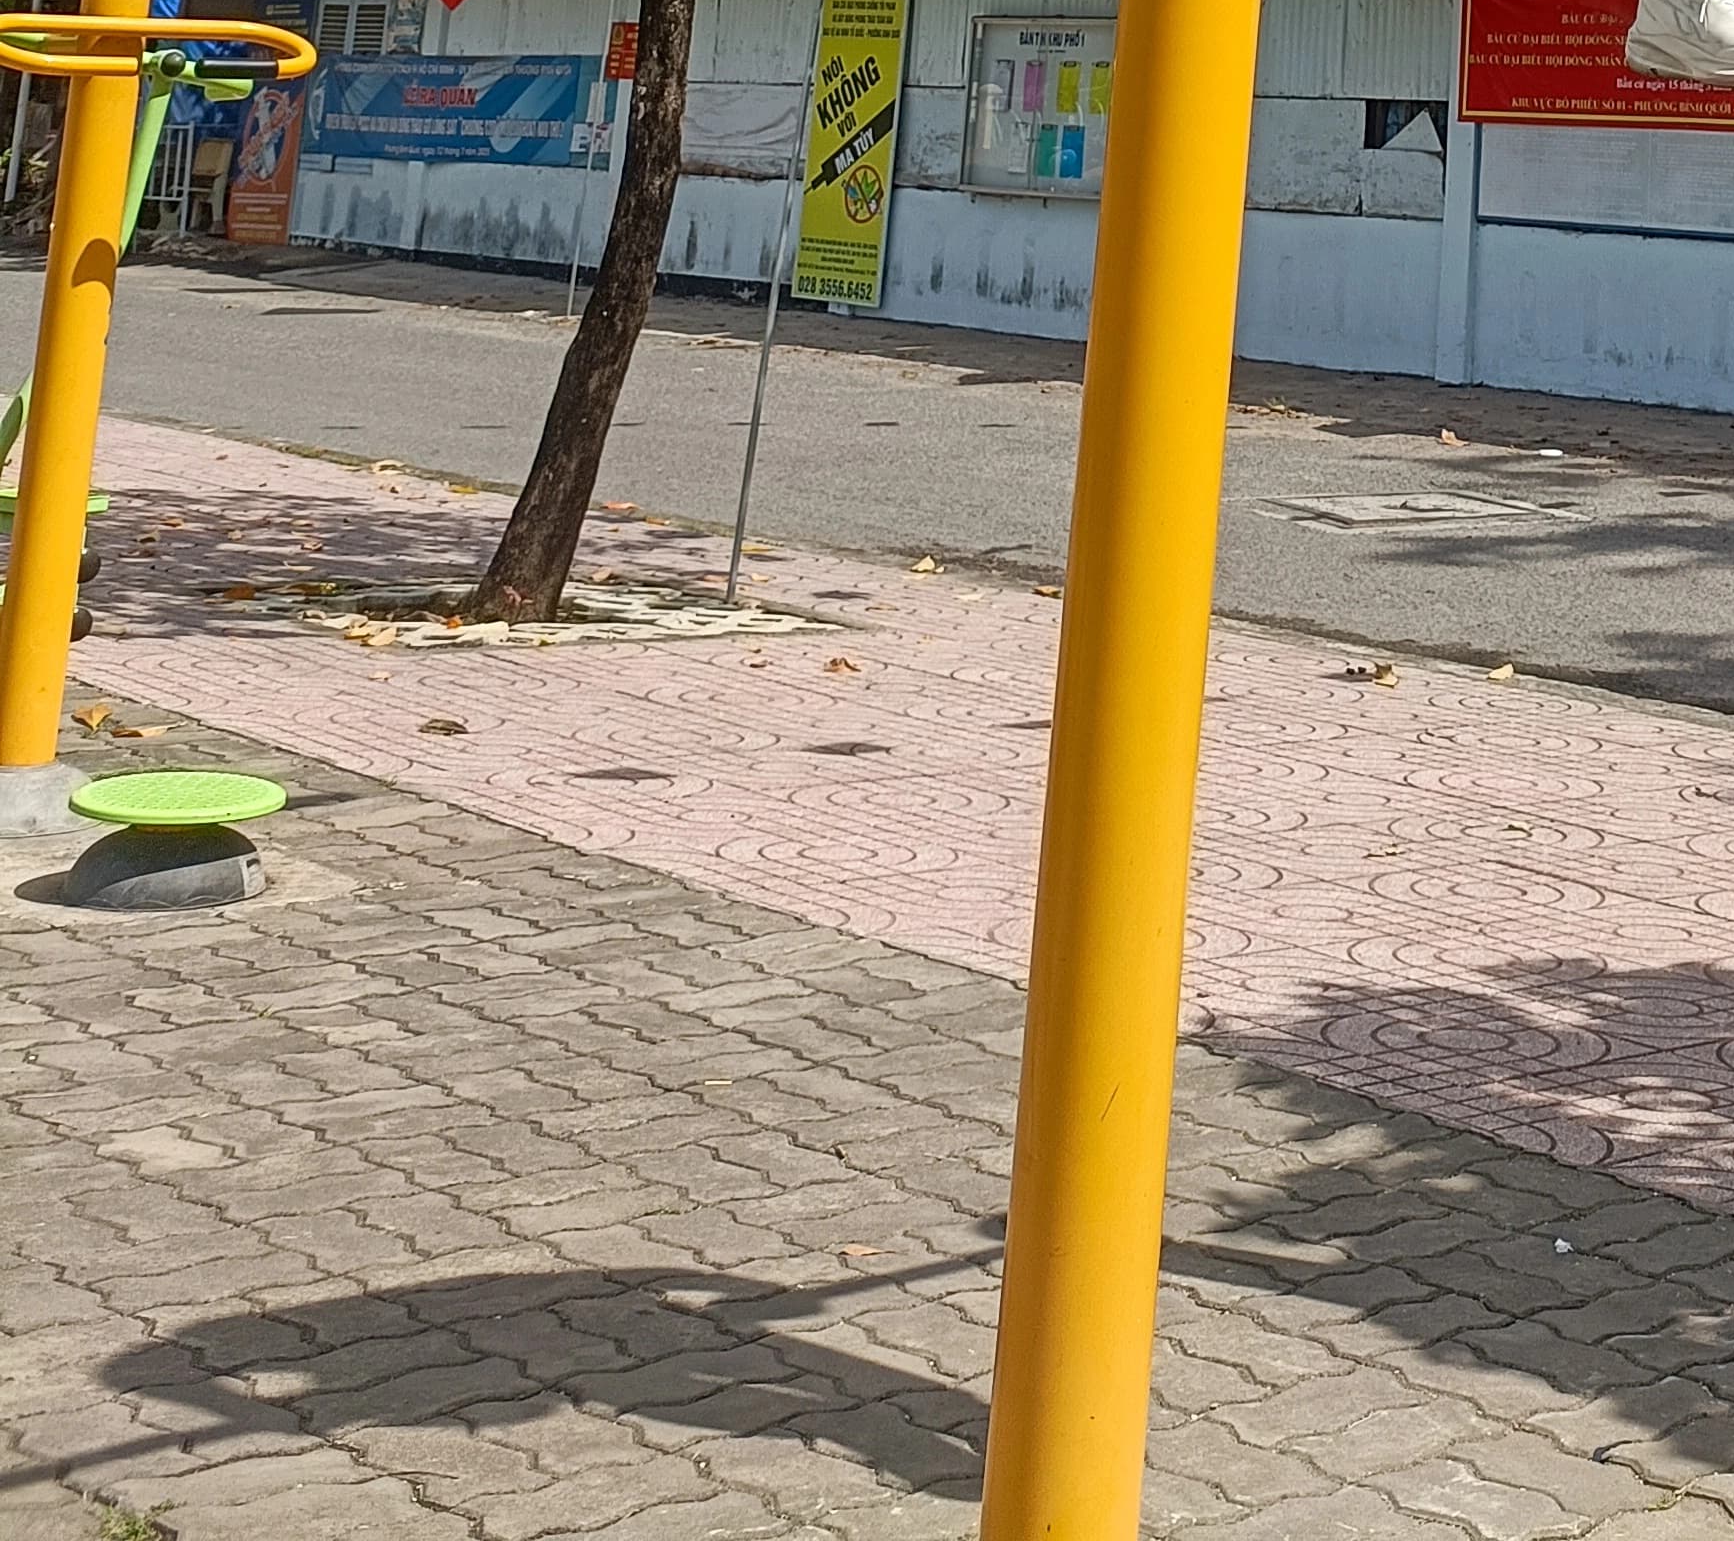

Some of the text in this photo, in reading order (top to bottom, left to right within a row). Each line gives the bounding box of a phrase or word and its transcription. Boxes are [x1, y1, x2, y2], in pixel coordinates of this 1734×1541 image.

[821, 55, 845, 87] NÓI
[816, 55, 881, 130] KHÔNG
[836, 110, 857, 138] VỚI
[834, 127, 876, 175] MA TÚY
[797, 275, 873, 301] 028 3556.6452
